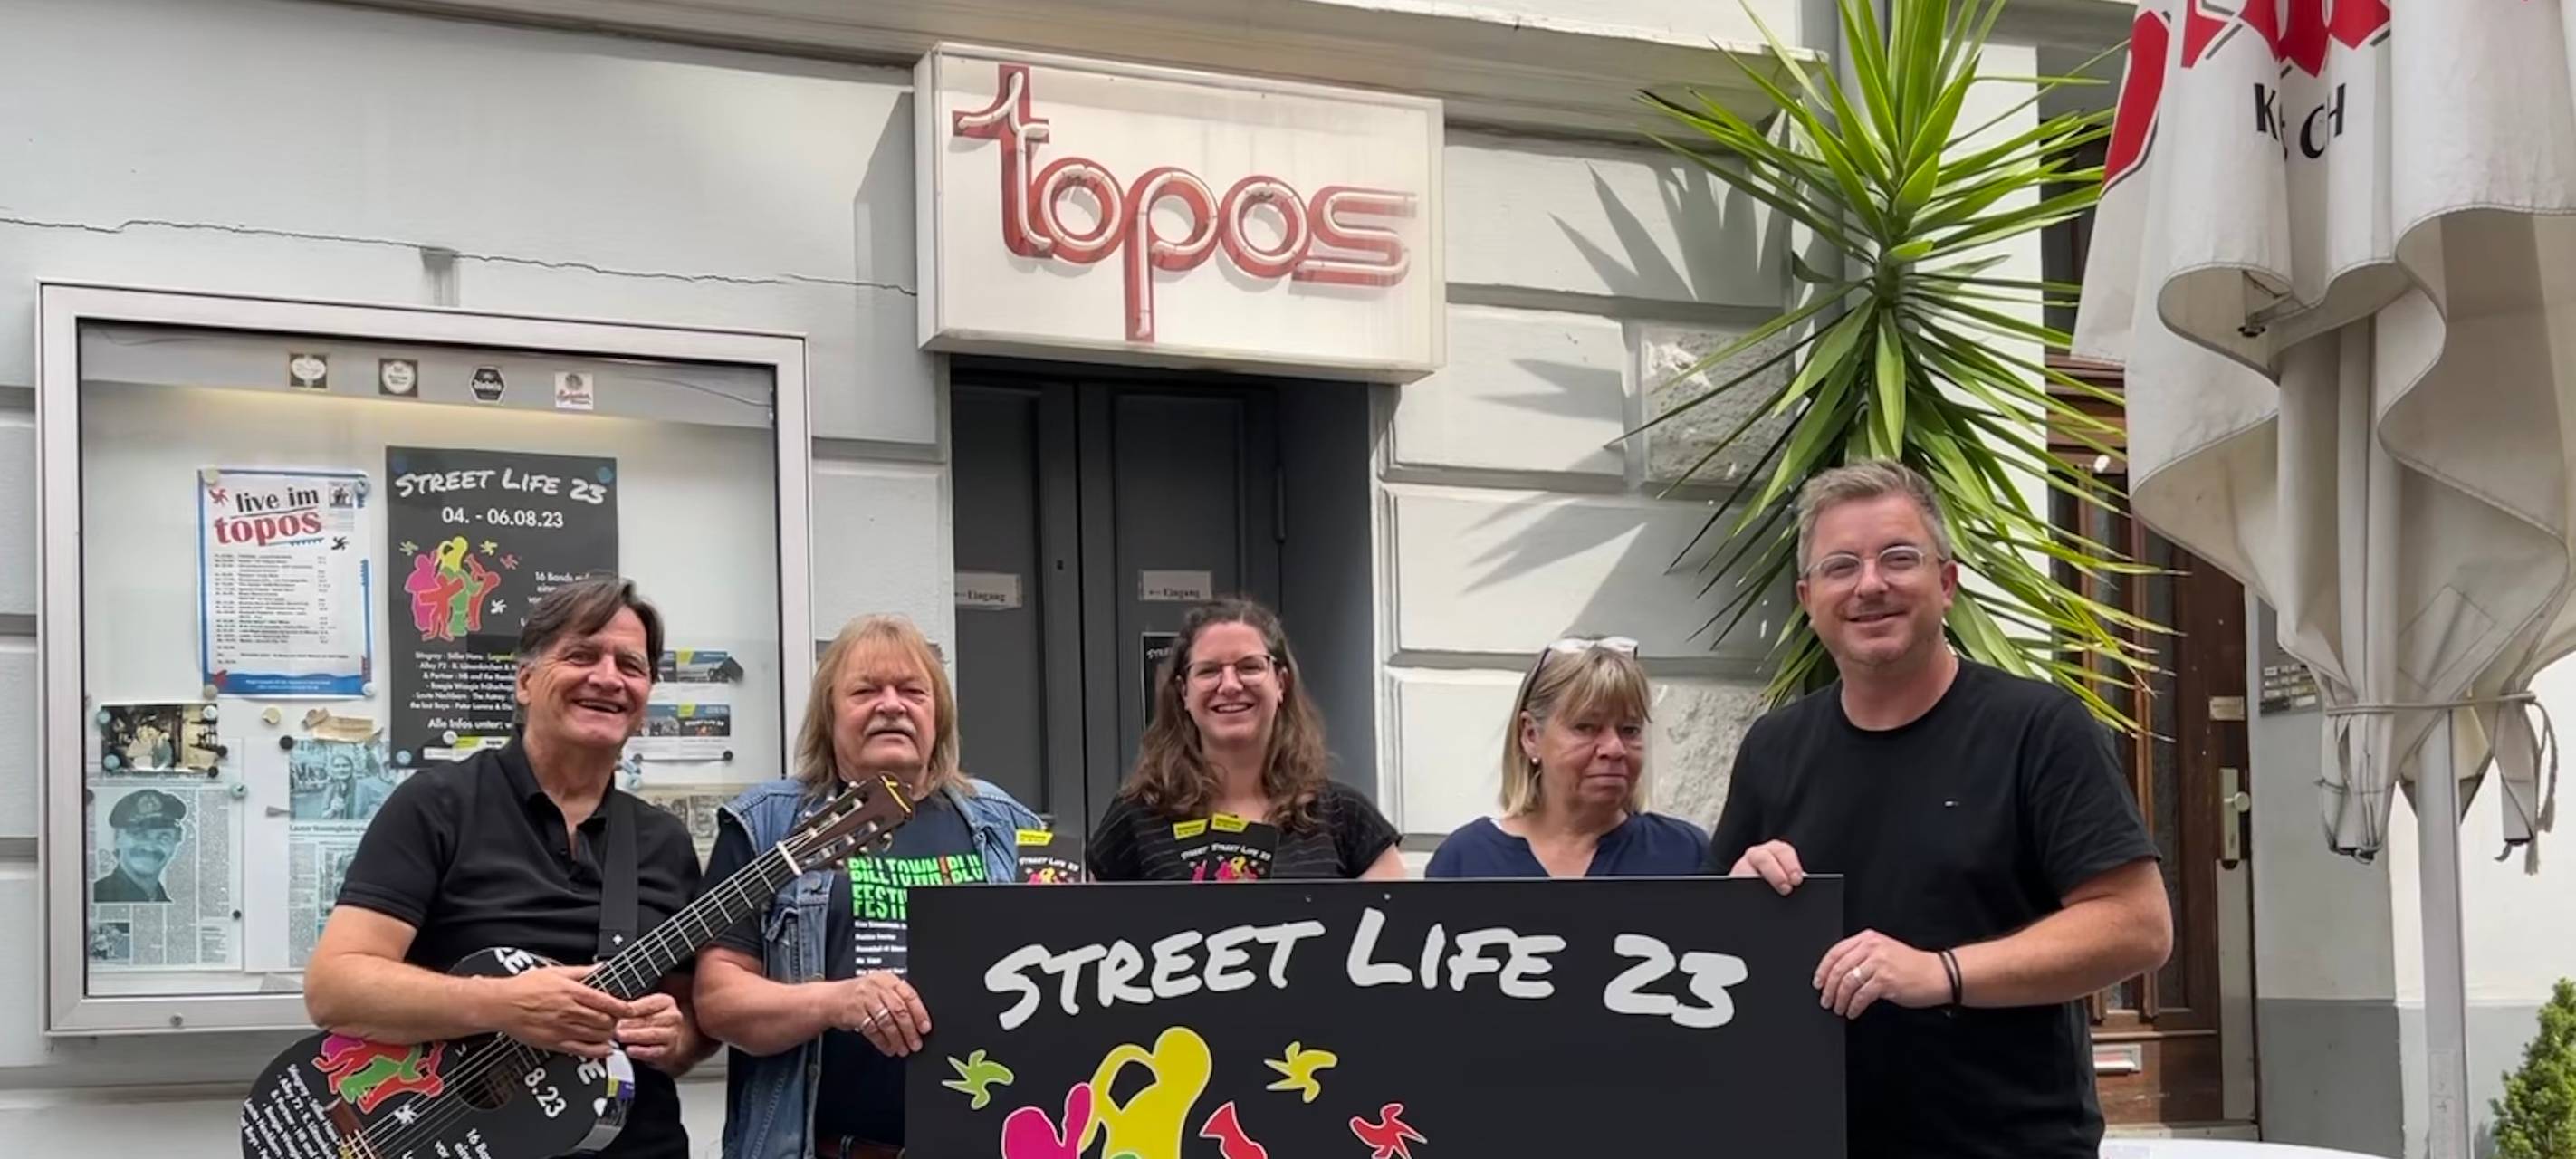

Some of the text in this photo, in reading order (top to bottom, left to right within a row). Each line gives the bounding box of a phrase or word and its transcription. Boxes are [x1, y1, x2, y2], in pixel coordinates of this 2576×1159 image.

[952, 64, 1419, 343] topos
[395, 468, 607, 504] STREET LIFE 23
[235, 487, 320, 512] live im
[214, 512, 321, 546] topos
[442, 507, 470, 524] 04.
[487, 508, 564, 528] 06.08.23
[967, 589, 1007, 603] Eingang
[1163, 587, 1200, 599] Eingang
[427, 717, 447, 730] Alle
[448, 717, 474, 730] Infos
[984, 907, 1748, 1030] STREET LIFE 23
